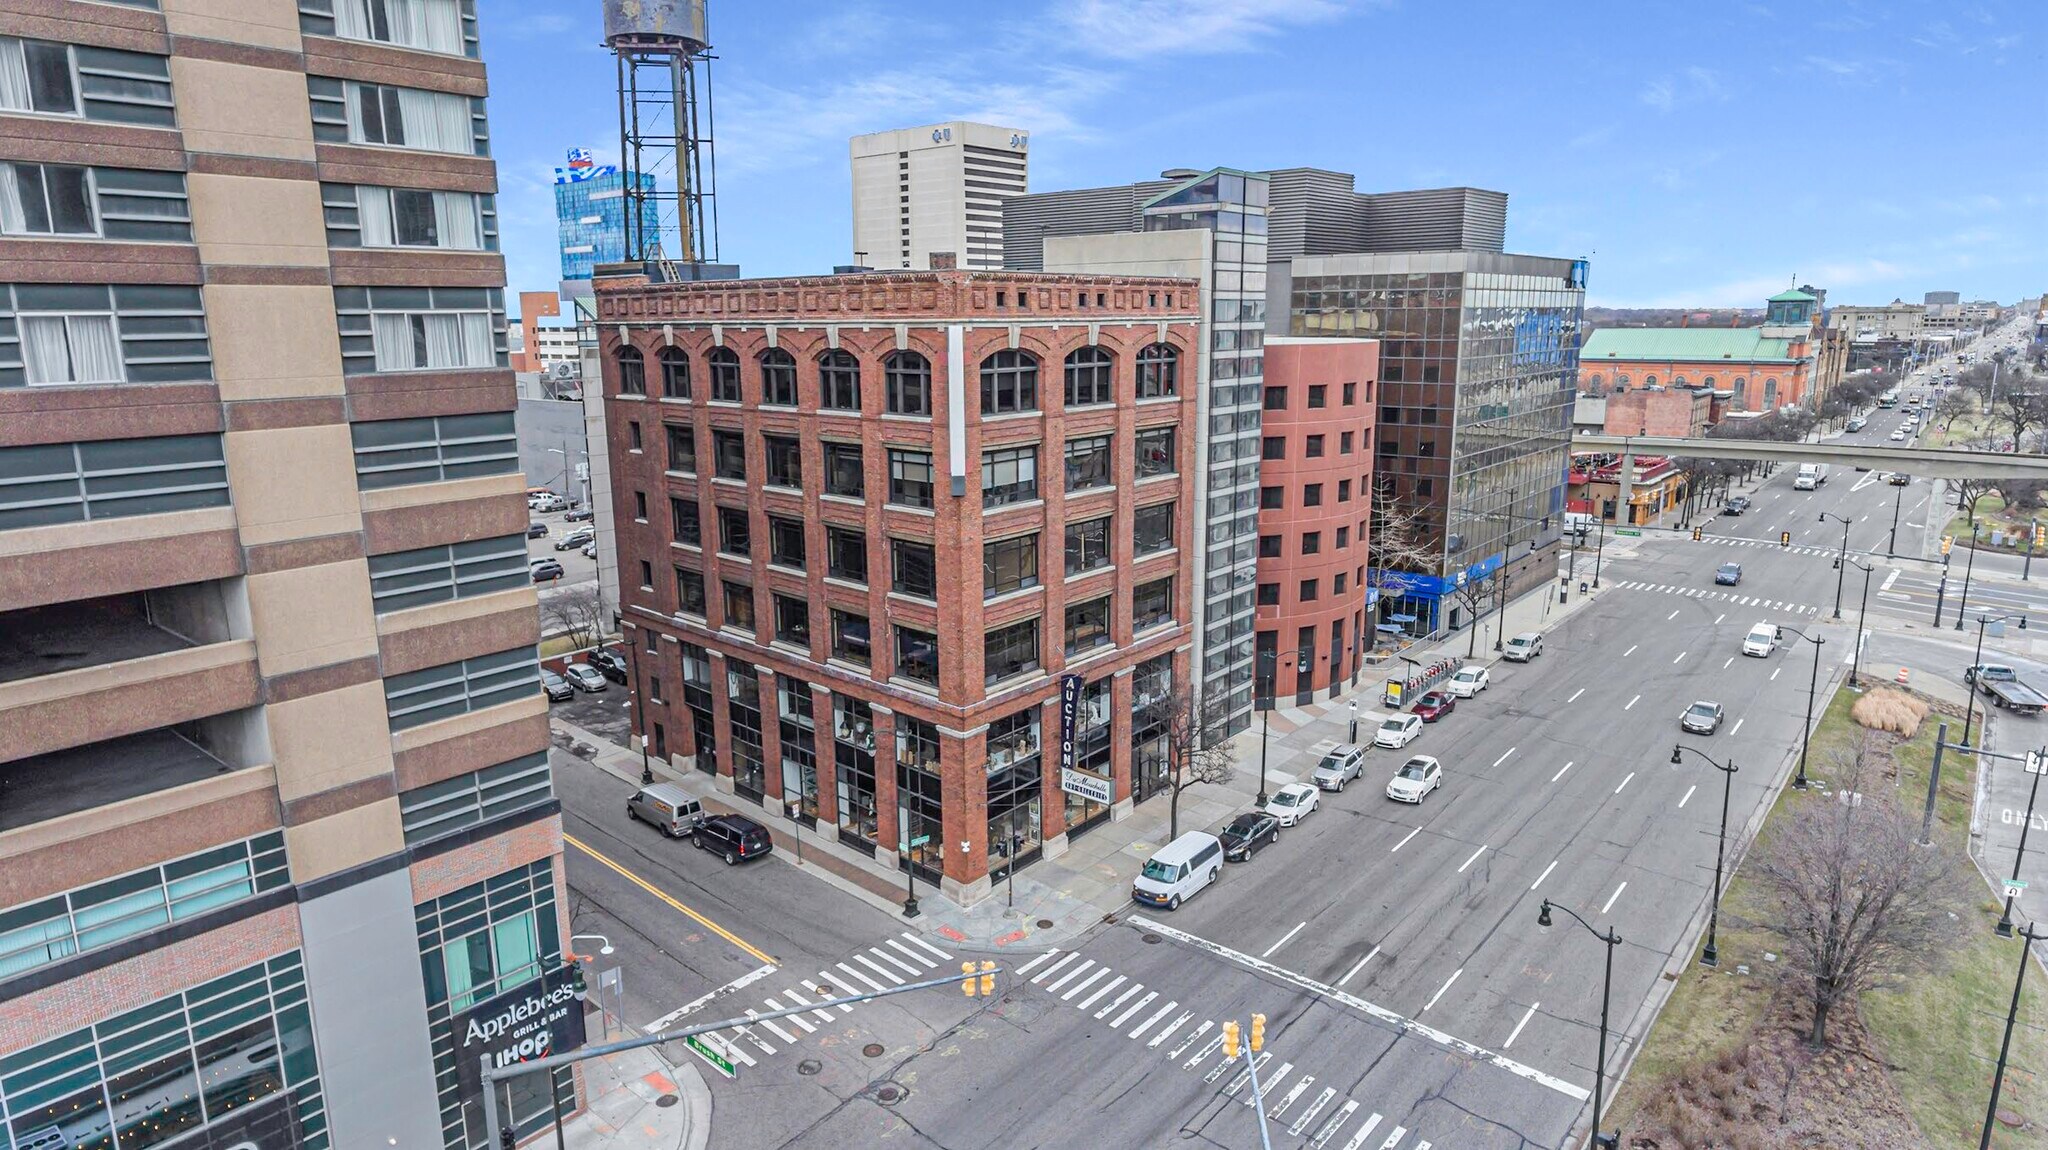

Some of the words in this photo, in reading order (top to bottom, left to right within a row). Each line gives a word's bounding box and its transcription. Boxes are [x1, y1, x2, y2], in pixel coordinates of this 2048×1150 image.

[1063, 677, 1075, 766] AUCTION
[463, 984, 574, 1047] Applebee's
[513, 1021, 540, 1039] GRILL
[541, 1016, 548, 1026] &
[549, 1008, 568, 1022] BAR
[496, 1031, 549, 1068] IHOP
[694, 1040, 715, 1060] Brush
